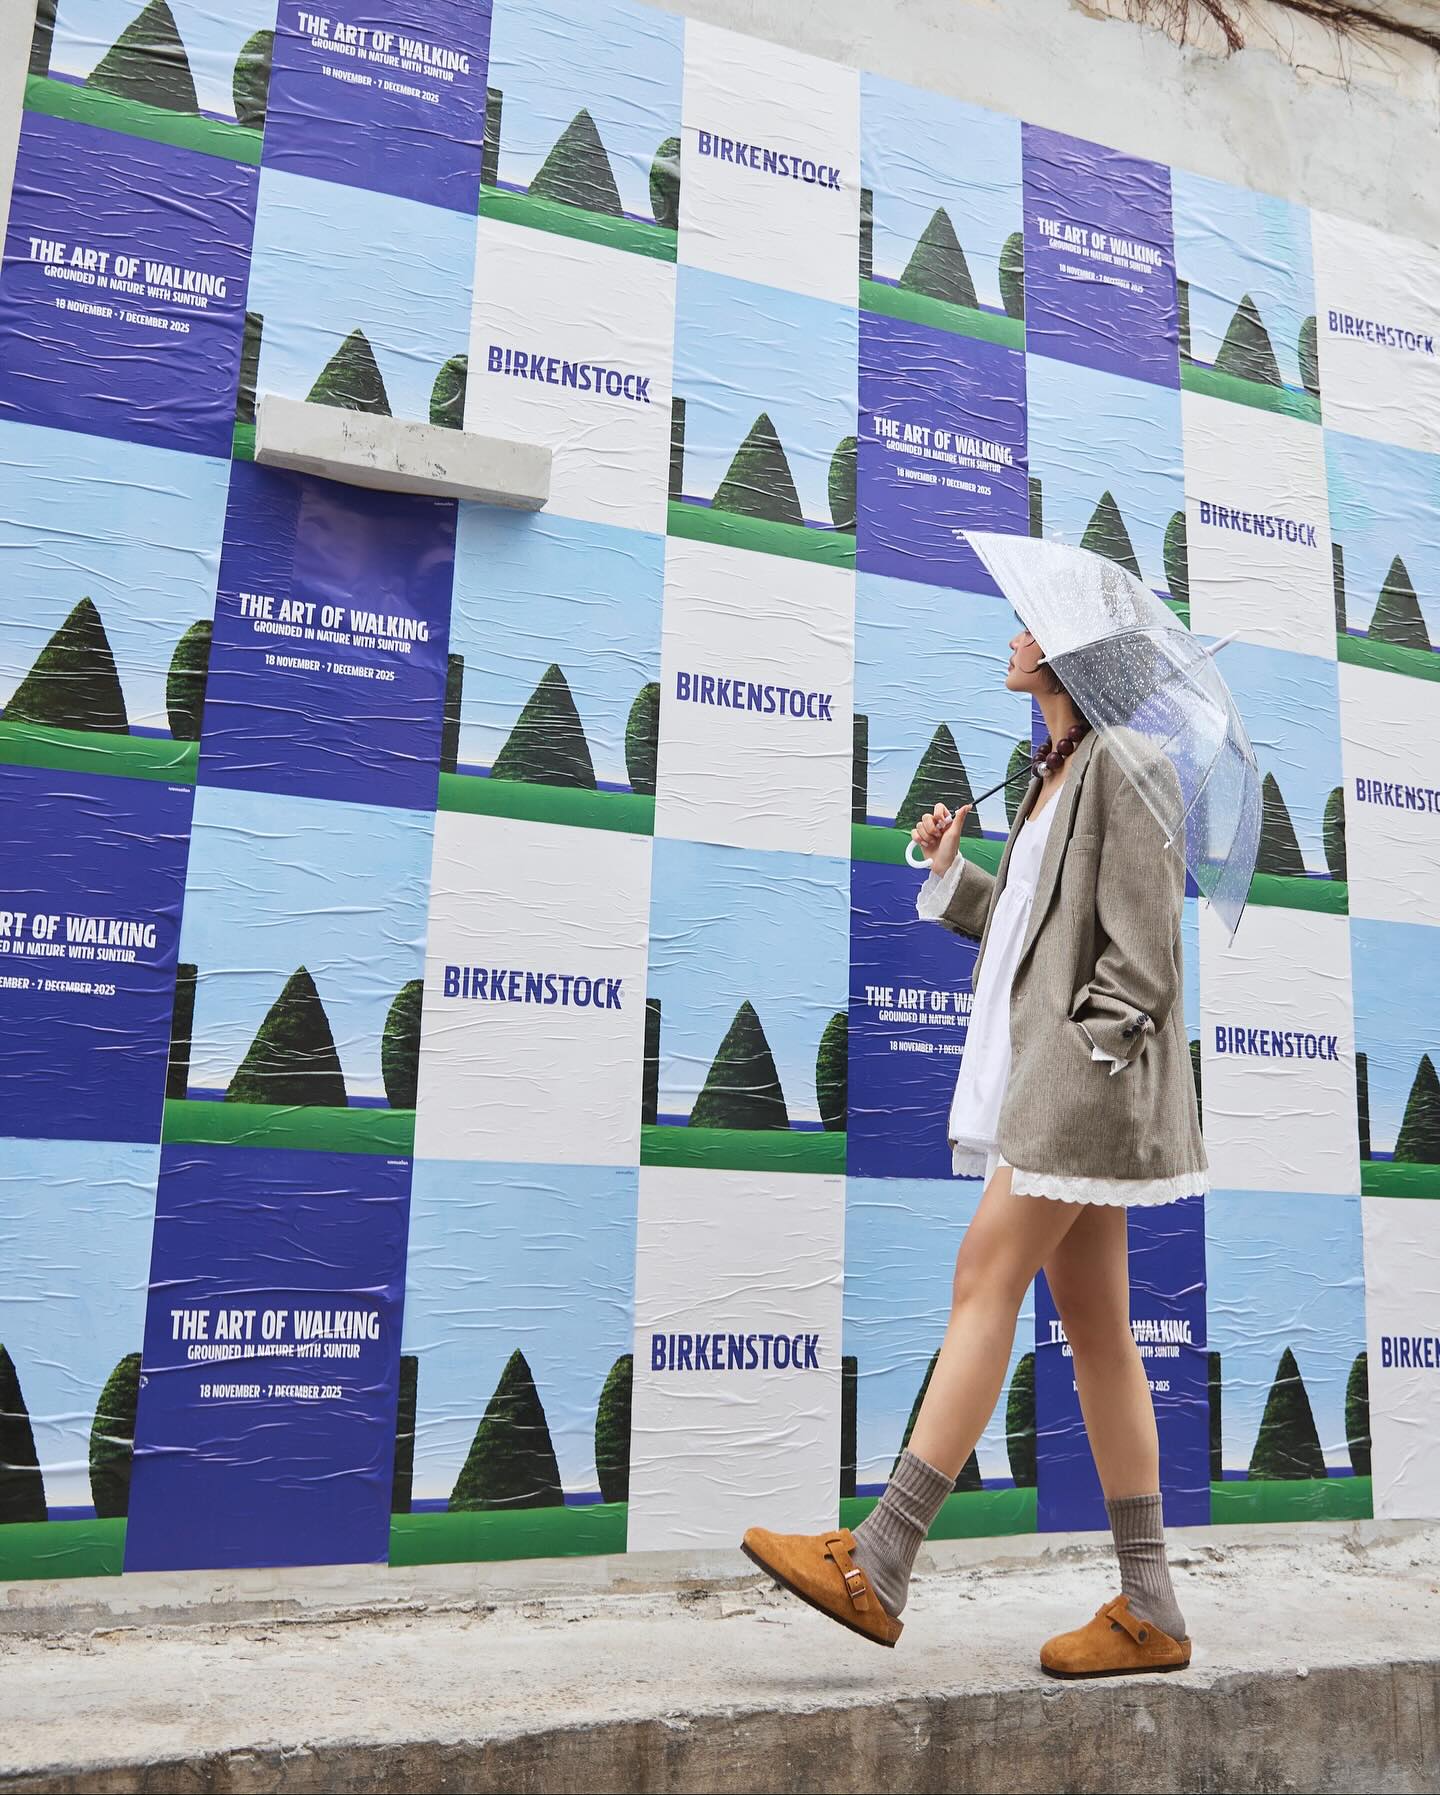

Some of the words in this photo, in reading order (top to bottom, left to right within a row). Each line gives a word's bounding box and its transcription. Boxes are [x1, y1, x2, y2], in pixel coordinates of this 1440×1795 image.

[298, 11, 330, 37] THE
[334, 23, 369, 46] ART
[372, 30, 394, 51] OF
[399, 37, 469, 74] WALKING
[312, 37, 356, 56] GROUNDED
[357, 48, 367, 59] IN
[368, 51, 400, 68] NATURE
[401, 58, 422, 73] WITH
[423, 64, 454, 82] SUNTUR
[322, 66, 331, 76] 18
[333, 68, 372, 86] NOVEMBER
[378, 80, 383, 88] 7
[384, 81, 420, 98] DECEMBER
[422, 90, 440, 103] 2025
[698, 130, 840, 191] BIRKENSTOCK
[1037, 216, 1061, 238] THE
[1064, 224, 1088, 246] ART
[1091, 232, 1107, 251] OF
[1110, 237, 1162, 267] WALKING
[29, 237, 66, 264] THE
[70, 247, 110, 272] ART
[114, 256, 140, 279] OF
[145, 262, 227, 298] WALKING
[44, 265, 95, 285] GROUNDED
[97, 276, 108, 288] IN
[109, 279, 145, 296] NATURE
[147, 286, 170, 301] WITH
[172, 290, 208, 308] SUNTUR
[55, 298, 66, 308] 18
[67, 299, 113, 318] NOVEMBER
[119, 311, 125, 321] 7
[126, 312, 168, 330] DECEMBER
[170, 321, 190, 333] 2025
[1328, 310, 1434, 354] BIRKENSTOCK
[487, 345, 651, 403] BIRKENSTOCK
[873, 416, 900, 439] THE
[903, 423, 931, 446] ART
[934, 430, 952, 450] OF
[955, 435, 1013, 465] WALKING
[886, 440, 922, 456] GROUNDED
[923, 448, 931, 458] IN
[932, 449, 958, 464] NATURE
[958, 455, 975, 468] WITH
[976, 460, 1001, 473] SUNTUR
[896, 467, 905, 477] 18
[905, 469, 937, 484] NOVEMBER
[941, 477, 946, 486] 7
[946, 478, 976, 493] DECEMBER
[977, 485, 992, 496] 2025
[1200, 500, 1317, 548] BIRKENSTOCK
[239, 593, 275, 619] THE
[279, 599, 316, 625] ART
[321, 605, 346, 629] OF
[350, 609, 429, 642] WALKING
[254, 620, 302, 638] GROUNDED
[305, 628, 315, 640] IN
[316, 629, 350, 645] NATURE
[353, 635, 375, 648] WITH
[377, 638, 411, 654] SUNTUR
[265, 654, 275, 665] 18
[276, 655, 320, 671] NOVEMBER
[327, 662, 332, 673] 7
[333, 663, 374, 679] DECEMBER
[375, 670, 395, 681] 2025
[676, 671, 833, 722] BIRKENSTOCK
[32, 914, 61, 940] OF
[66, 916, 157, 949] WALKING
[12, 942, 25, 954] IN
[26, 942, 66, 957] NATURE
[69, 946, 97, 959] WITH
[97, 948, 136, 963] SUNTUR
[37, 979, 43, 990] 7
[44, 980, 92, 995] DECEMBER
[93, 983, 116, 996] 2025
[444, 965, 623, 1010] BIRKENSTOCK
[865, 985, 894, 1008] THE
[898, 988, 927, 1010] ART
[930, 991, 950, 1012] OF
[879, 1010, 918, 1024] GROUNDED
[919, 1013, 927, 1024] IN
[929, 1014, 956, 1026] NATURE
[957, 1015, 971, 1027] WIT
[889, 1040, 898, 1051] 18
[899, 1041, 933, 1054] NOVEMBER
[938, 1044, 942, 1054] 7
[1215, 1026, 1339, 1061] BIRKENSTOCK
[170, 1309, 210, 1341] THE
[215, 1309, 257, 1340] ART
[261, 1310, 289, 1340] OF
[293, 1310, 380, 1340] WALKING
[1132, 1320, 1192, 1344] WALKING
[187, 1344, 242, 1360] GROUNDED
[243, 1344, 255, 1358] IN
[257, 1344, 295, 1358] NATURE
[297, 1344, 321, 1358] WITH
[322, 1343, 360, 1359] SUNTUR
[651, 1334, 820, 1371] BIRKENSTOCK
[1154, 1345, 1180, 1358] SUNTUR
[200, 1384, 211, 1398] 18
[212, 1384, 260, 1398] NOVEMBER
[267, 1385, 274, 1398] 7
[274, 1385, 319, 1399] DECEMBER
[321, 1385, 342, 1398] 2025
[1155, 1380, 1170, 1392] 2025
